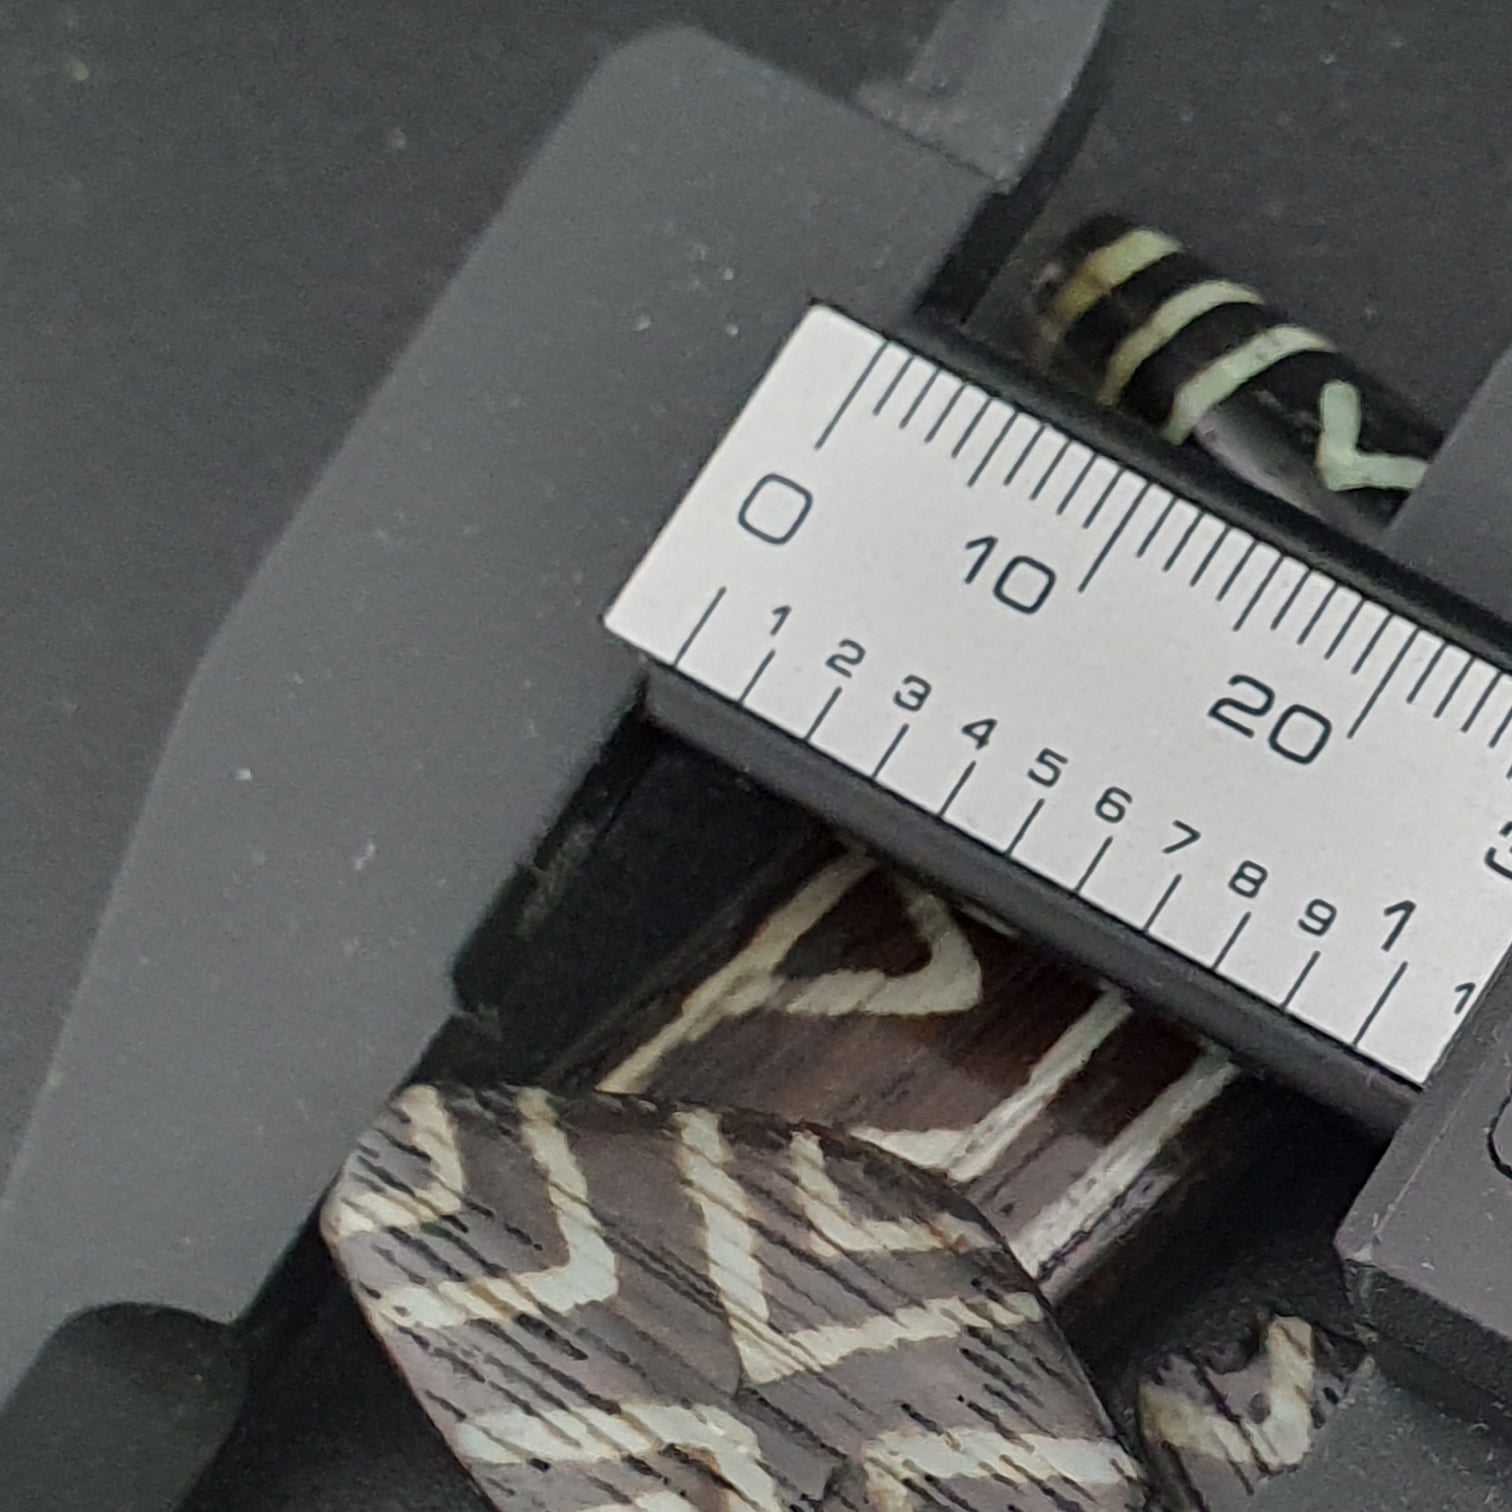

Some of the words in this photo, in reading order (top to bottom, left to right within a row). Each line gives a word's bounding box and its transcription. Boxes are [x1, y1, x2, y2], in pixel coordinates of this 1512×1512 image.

[738, 473, 813, 545] 0
[962, 534, 1056, 615] 10
[1208, 672, 1334, 767] 20
[770, 604, 791, 636] 1
[826, 638, 866, 678] 2
[893, 674, 933, 713] 3
[961, 716, 1000, 751] 4
[1027, 747, 1069, 788] 5
[1094, 785, 1134, 824] 6
[1162, 820, 1201, 857] 7
[1228, 859, 1268, 898] 8
[1296, 898, 1337, 937] 9
[1382, 898, 1417, 951] 1
